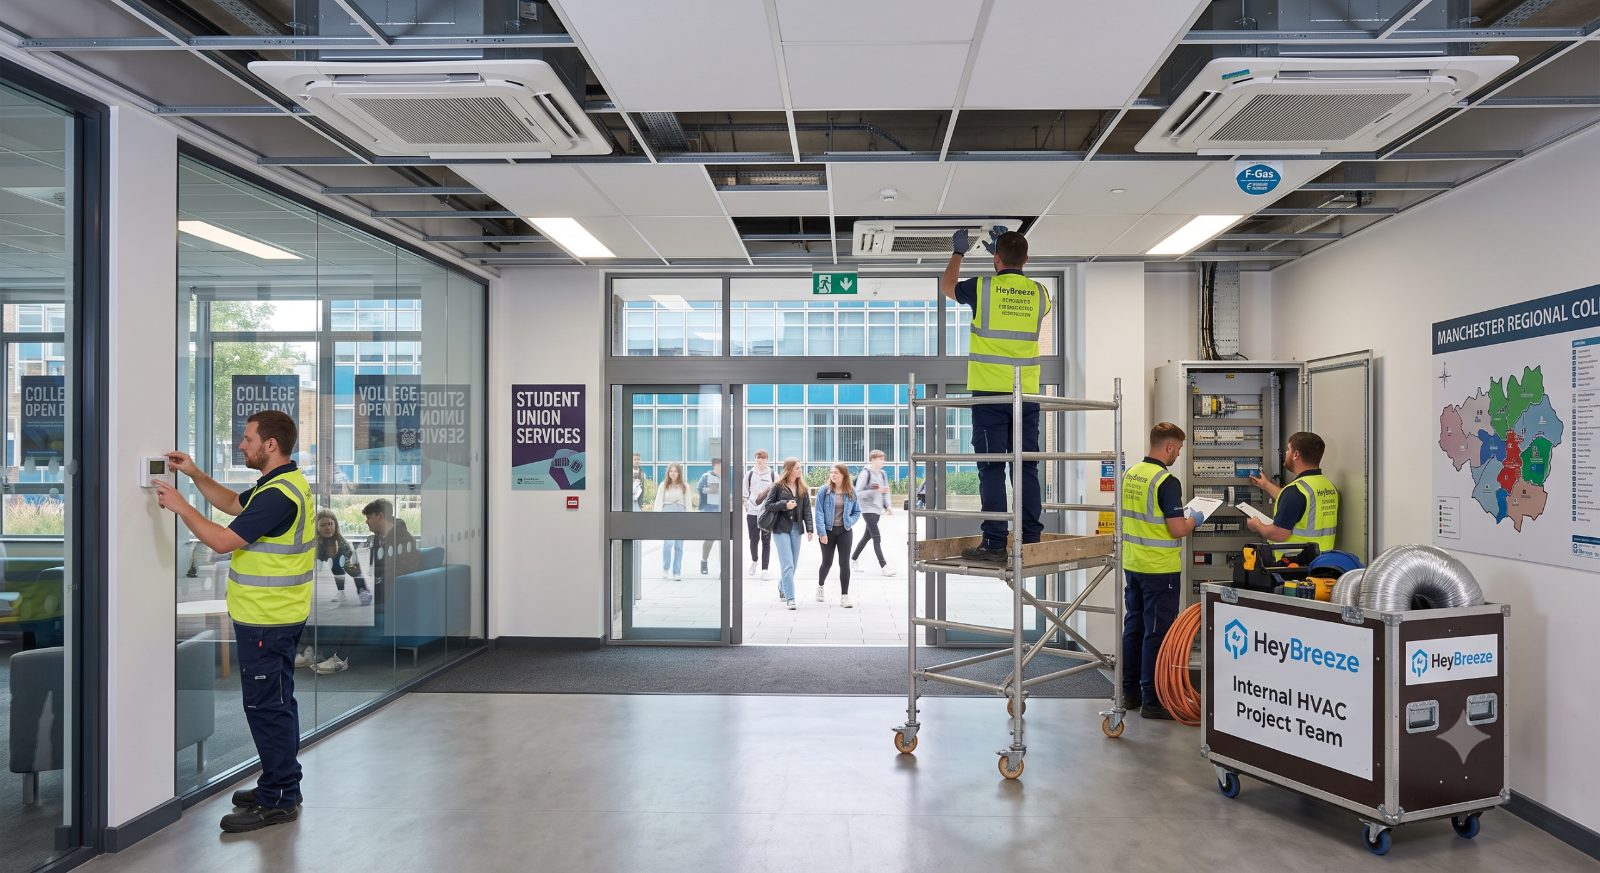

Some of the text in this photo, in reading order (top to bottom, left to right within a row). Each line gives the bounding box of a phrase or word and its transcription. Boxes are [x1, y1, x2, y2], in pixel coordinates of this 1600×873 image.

[1245, 169, 1274, 179] F-Gas
[995, 286, 1036, 296] HeyBreeze
[1437, 298, 1600, 346] MANCHESTER REGIONAL COL
[236, 386, 295, 402] COLLEGE
[516, 391, 581, 407] STUDENT
[25, 403, 56, 417] OPEN
[359, 402, 417, 417] OPEN DAY
[516, 409, 561, 426] UNION
[516, 428, 581, 444] SERVICES
[1254, 630, 1360, 674] HeyBreeze
[1431, 648, 1494, 672] HeyBreeze
[1232, 675, 1347, 721] Internal HVAC
[1236, 701, 1343, 748] Project Team
